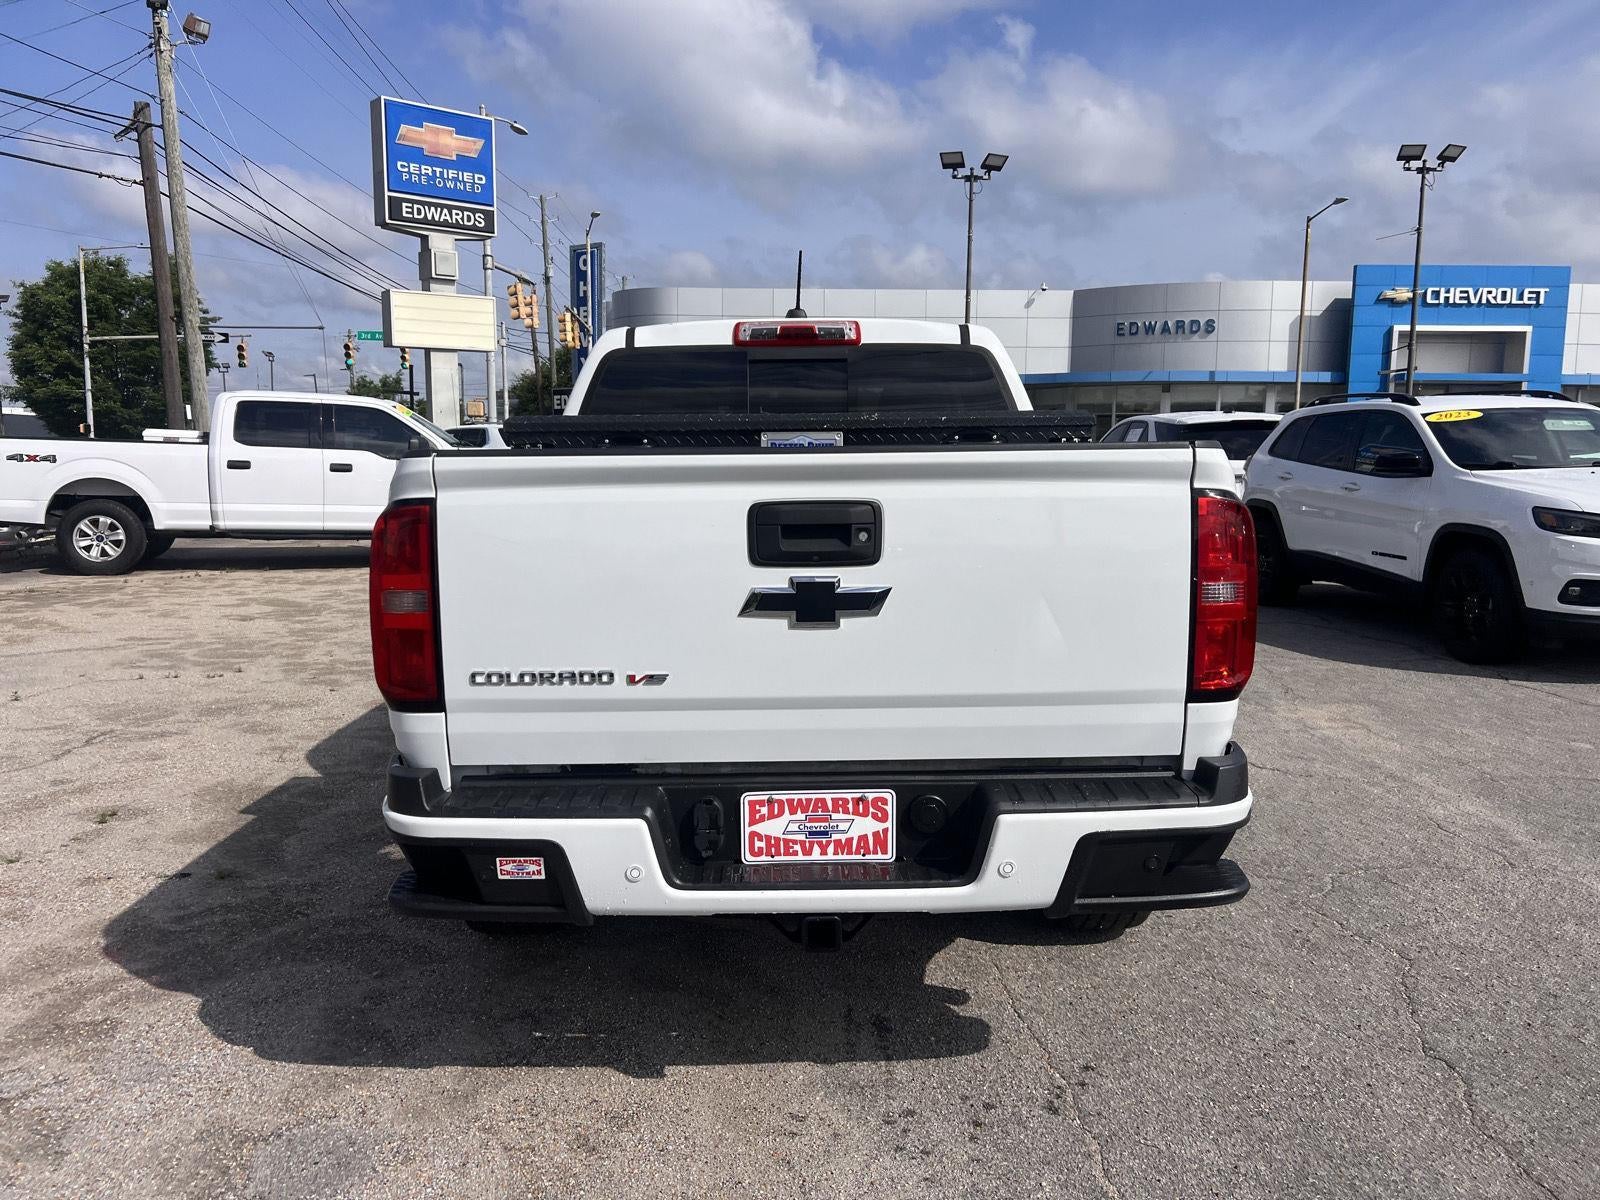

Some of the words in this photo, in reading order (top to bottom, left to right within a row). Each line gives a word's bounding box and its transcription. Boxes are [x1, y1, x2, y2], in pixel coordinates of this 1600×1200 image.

[397, 161, 486, 185] CERTIFIED
[402, 173, 482, 193] PRE-OWNED
[401, 202, 485, 228] EDWARDS
[1426, 287, 1549, 304] CHEVROLET
[1116, 319, 1216, 336] EDWARDS
[1436, 411, 1472, 421] 2023
[469, 670, 615, 687] COLORADO
[748, 796, 889, 827] EDWARDS
[797, 823, 840, 831] Chevrolet
[748, 827, 889, 858] CHEVYMAN
[499, 859, 542, 868] EDWARDS
